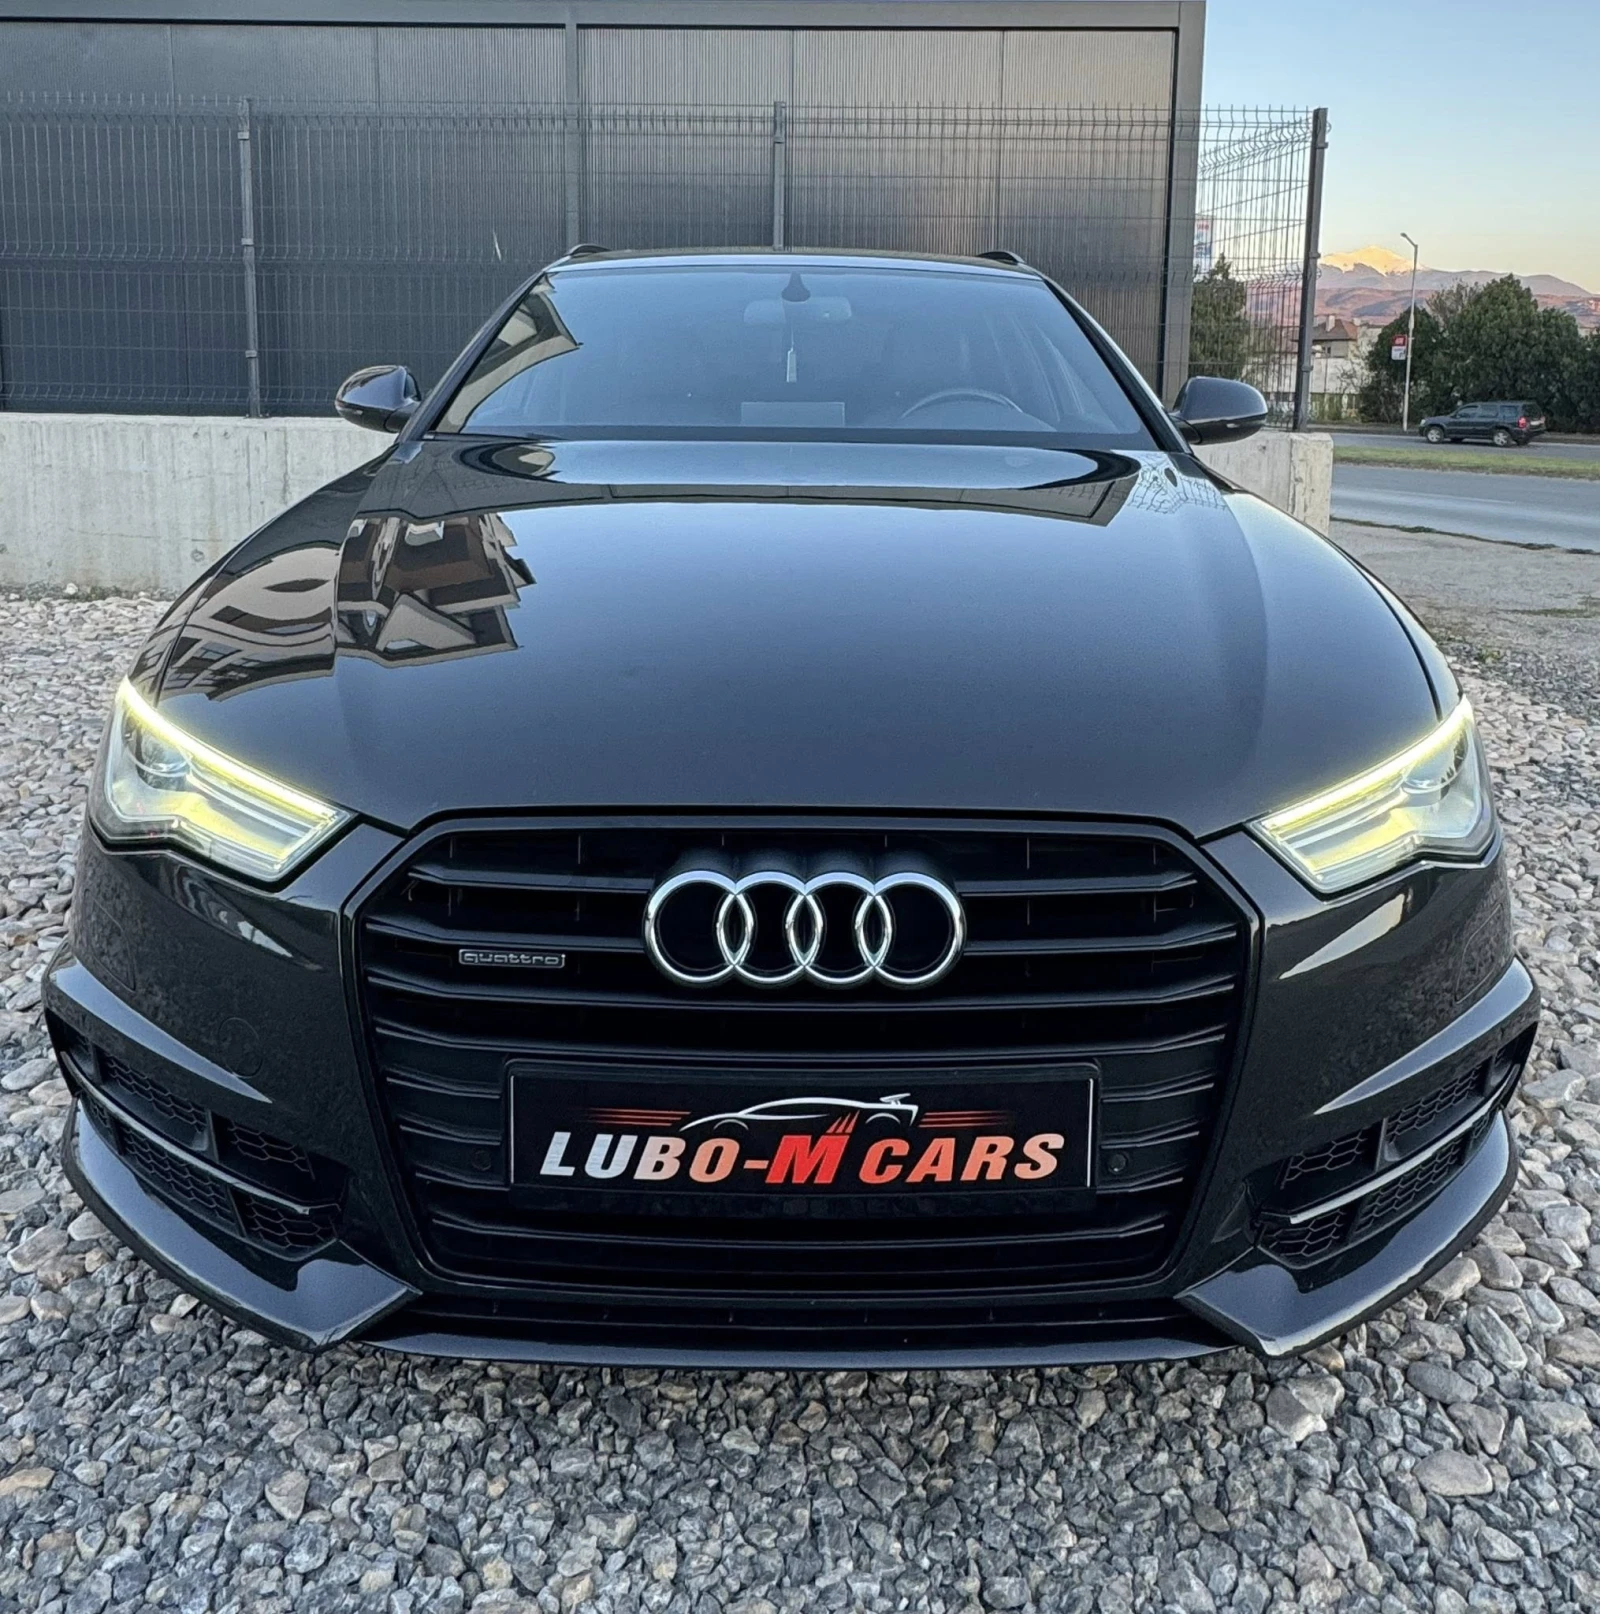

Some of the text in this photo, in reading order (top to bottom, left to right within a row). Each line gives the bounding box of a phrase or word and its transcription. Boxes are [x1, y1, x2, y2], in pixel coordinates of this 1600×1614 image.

[464, 953, 560, 965] quattro
[539, 1131, 1065, 1185] LUBO-M CARS
